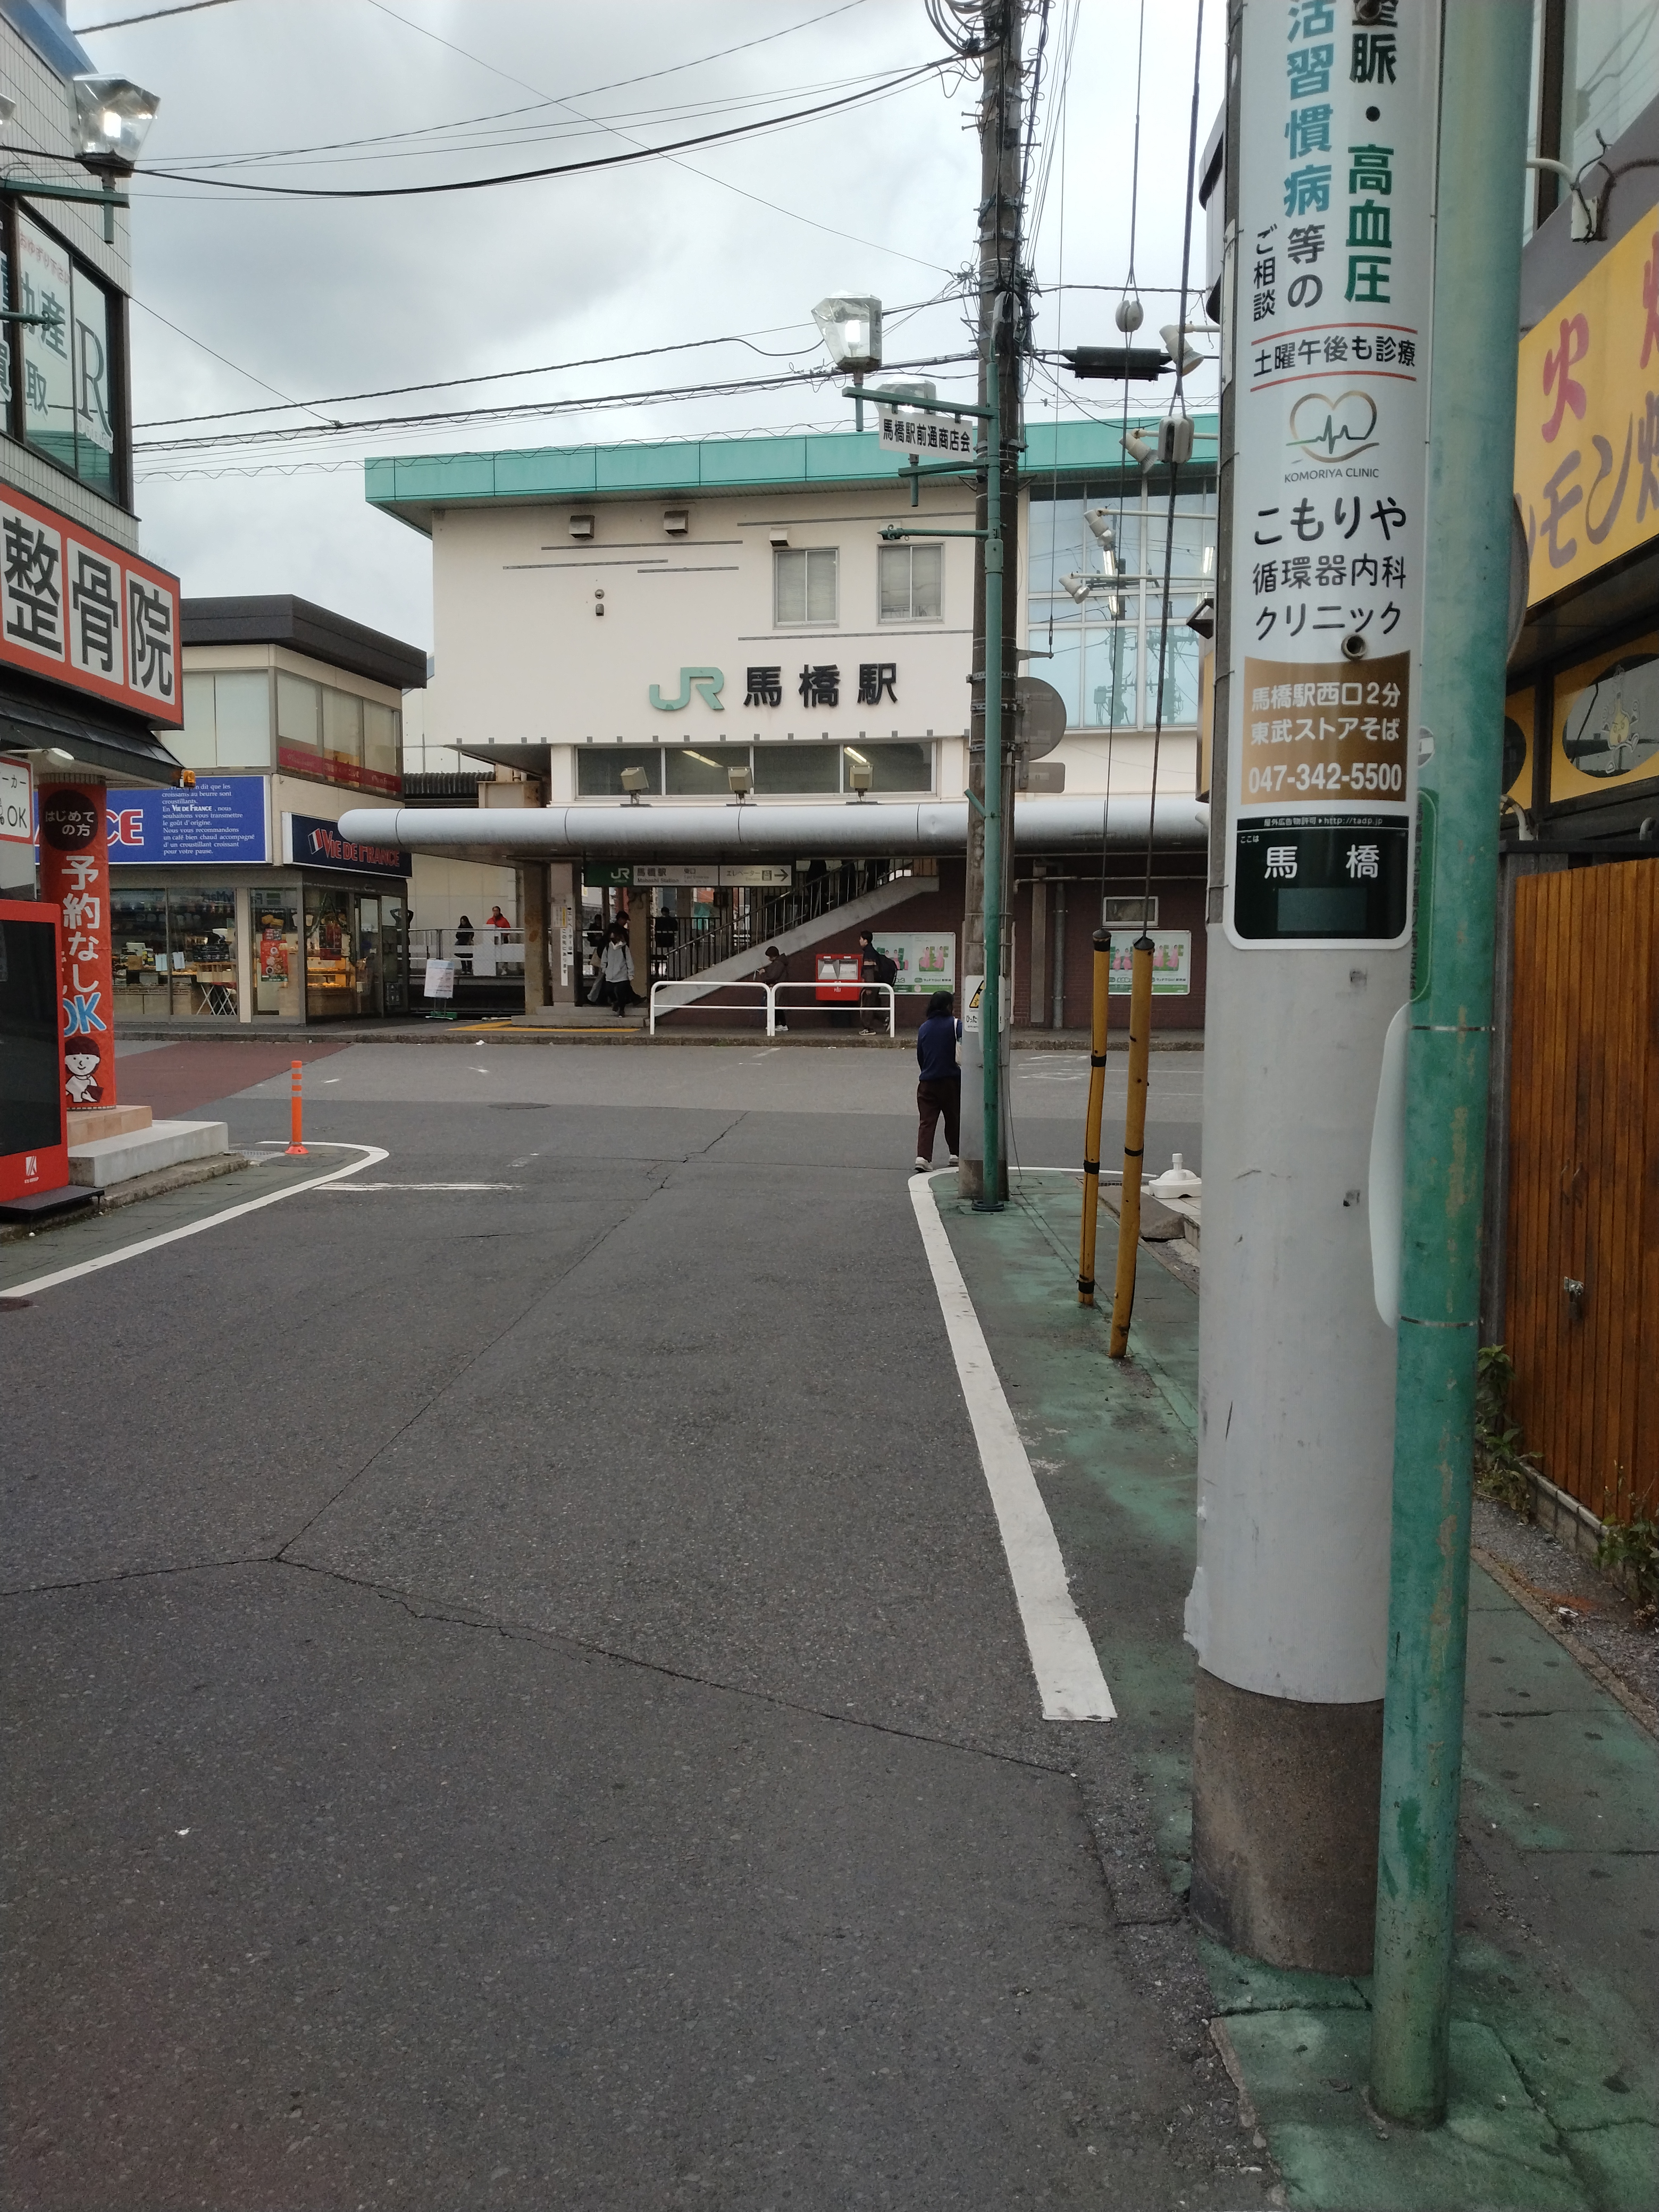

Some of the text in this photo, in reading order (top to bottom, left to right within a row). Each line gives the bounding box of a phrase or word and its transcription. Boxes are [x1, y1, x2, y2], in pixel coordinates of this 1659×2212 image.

[1253, 223, 1277, 322] ご相談
[1254, 336, 1416, 377] 土曜午後も診療
[76, 317, 112, 438] R
[883, 418, 970, 453] 馬橋駅前通商店会
[1284, 467, 1379, 483] KOMORIYA CLINIC
[1254, 496, 1406, 544] こもりや
[1253, 554, 1405, 596] 循環器内科
[3, 516, 172, 697] 整骨院
[1256, 601, 1401, 640] クリニック
[649, 663, 898, 711] JR 馬橋駅
[1251, 682, 1401, 711] 馬橋駅西口2分
[1251, 717, 1400, 745] 東武ストアそば
[1249, 763, 1402, 793] 047-342-5500
[45, 810, 95, 823] はじめて
[62, 824, 90, 836] の方
[1241, 835, 1259, 843] ここは
[611, 868, 629, 879] JR
[62, 855, 100, 993] 予約なし
